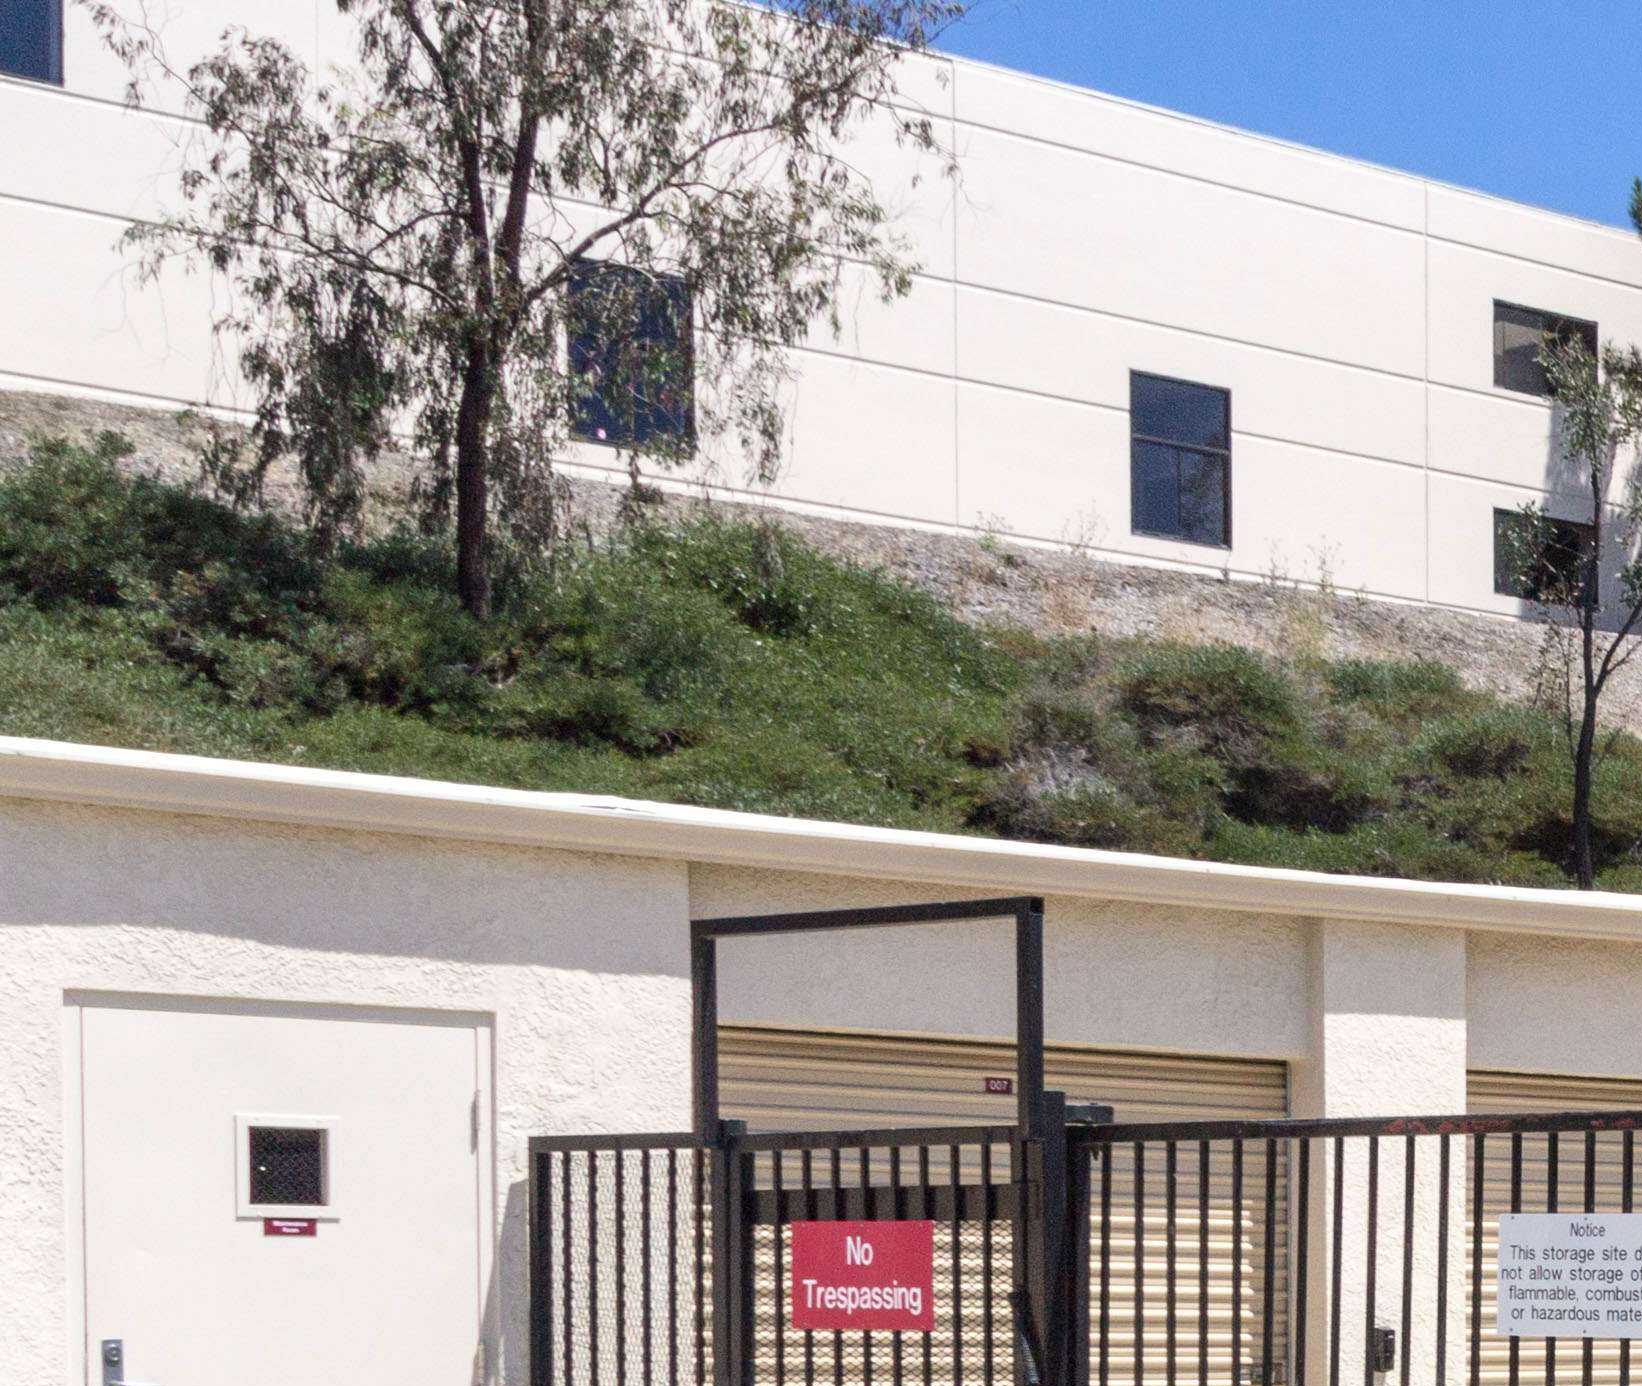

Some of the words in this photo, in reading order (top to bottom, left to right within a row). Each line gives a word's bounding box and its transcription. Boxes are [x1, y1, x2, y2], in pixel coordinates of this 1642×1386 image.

[1570, 1222, 1606, 1237] Notice
[846, 1236, 873, 1266] No
[1510, 1245, 1536, 1261] This
[1542, 1246, 1595, 1263] storage
[1602, 1246, 1627, 1261] site
[1501, 1266, 1522, 1280] not
[1529, 1265, 1562, 1281] allow
[1570, 1267, 1623, 1283] storage
[802, 1279, 922, 1315] Trespassing
[1509, 1286, 1579, 1302] flammable,
[1511, 1306, 1526, 1320] or
[1531, 1305, 1600, 1321] hazardous
